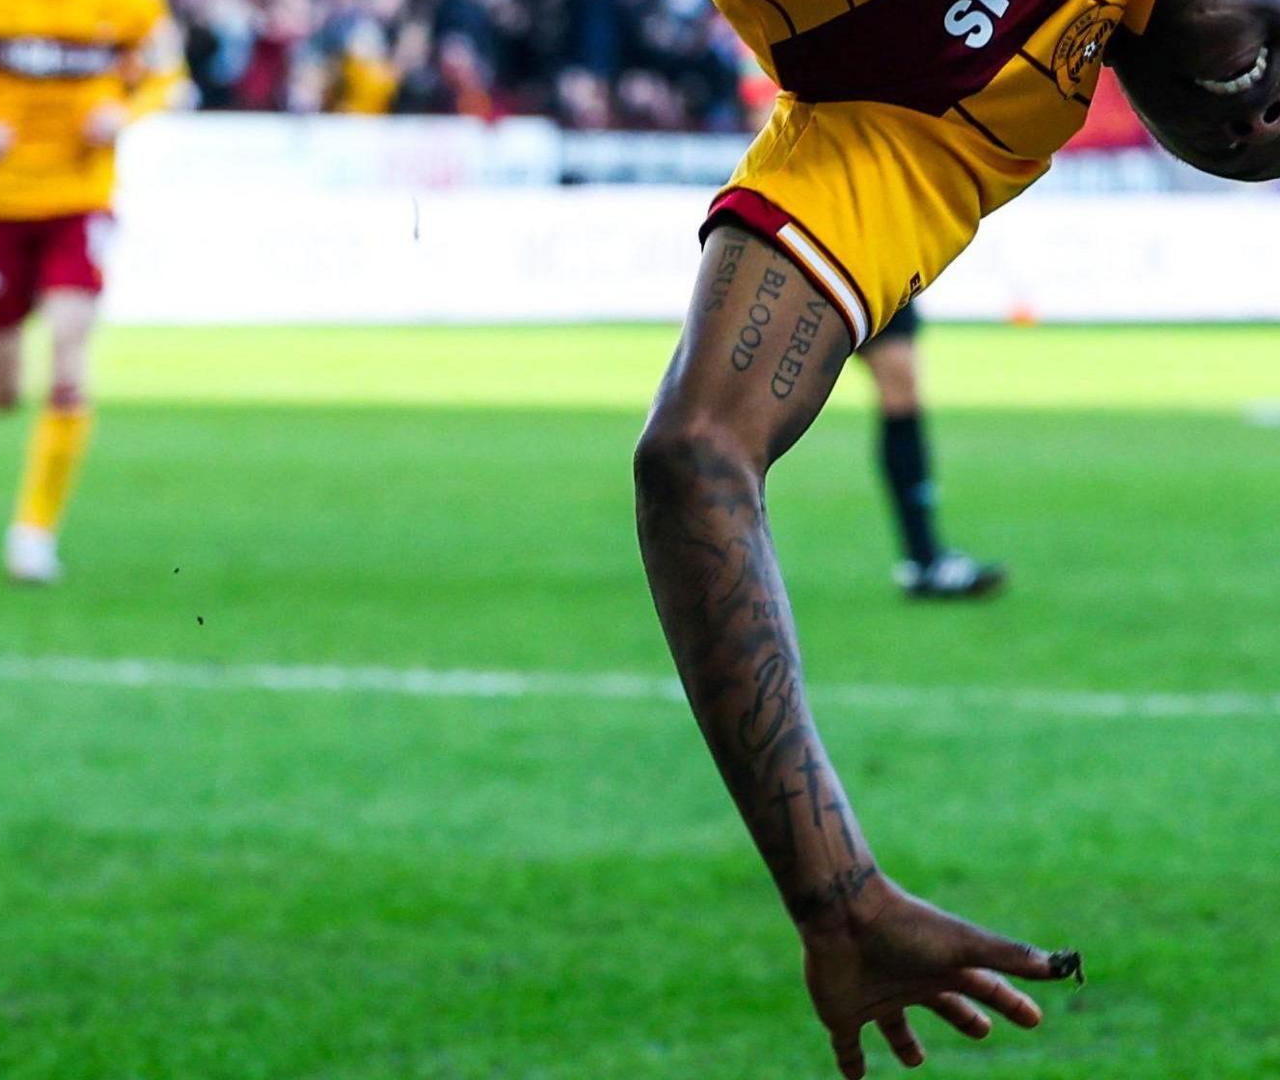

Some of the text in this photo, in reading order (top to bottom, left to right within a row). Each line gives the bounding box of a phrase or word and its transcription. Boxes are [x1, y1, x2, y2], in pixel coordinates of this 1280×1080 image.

[704, 244, 745, 313] ESUS
[732, 266, 787, 372] BLOOD
[771, 297, 828, 400] VERED
